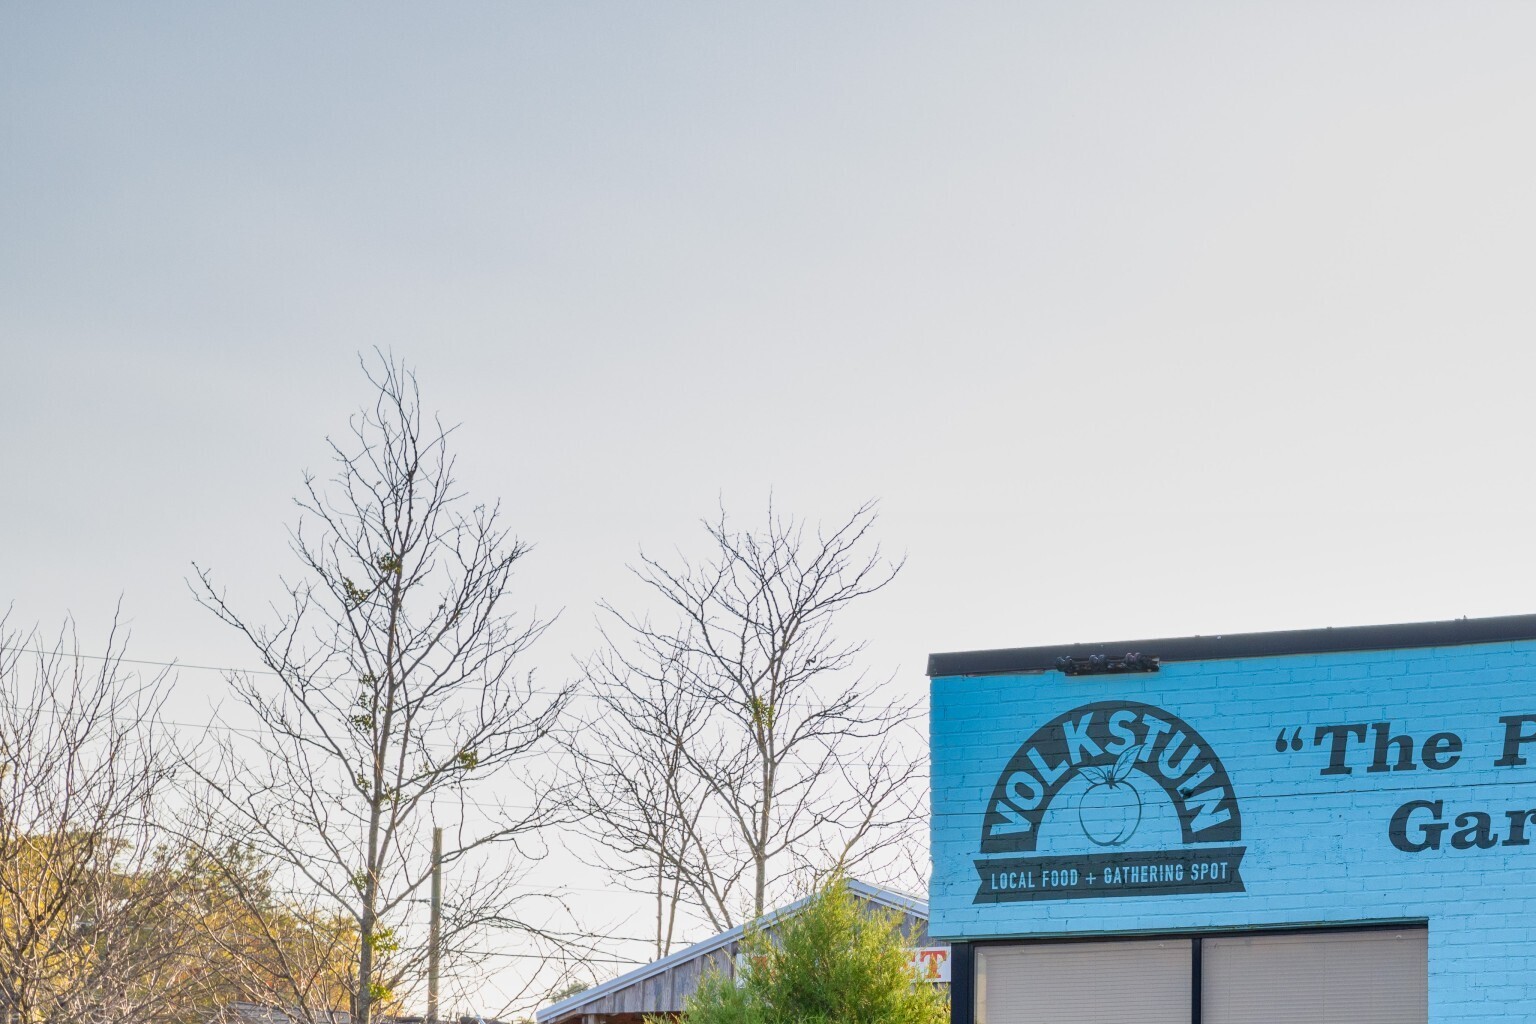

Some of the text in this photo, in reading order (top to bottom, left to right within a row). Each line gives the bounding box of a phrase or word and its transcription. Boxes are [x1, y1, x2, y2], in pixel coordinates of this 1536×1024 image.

[990, 709, 1232, 836] VOLKSTUIN
[991, 870, 1035, 890] LOCAL
[1042, 868, 1078, 888] FOOD
[1104, 864, 1184, 884] GATHERING
[1190, 862, 1228, 881] SPOT
